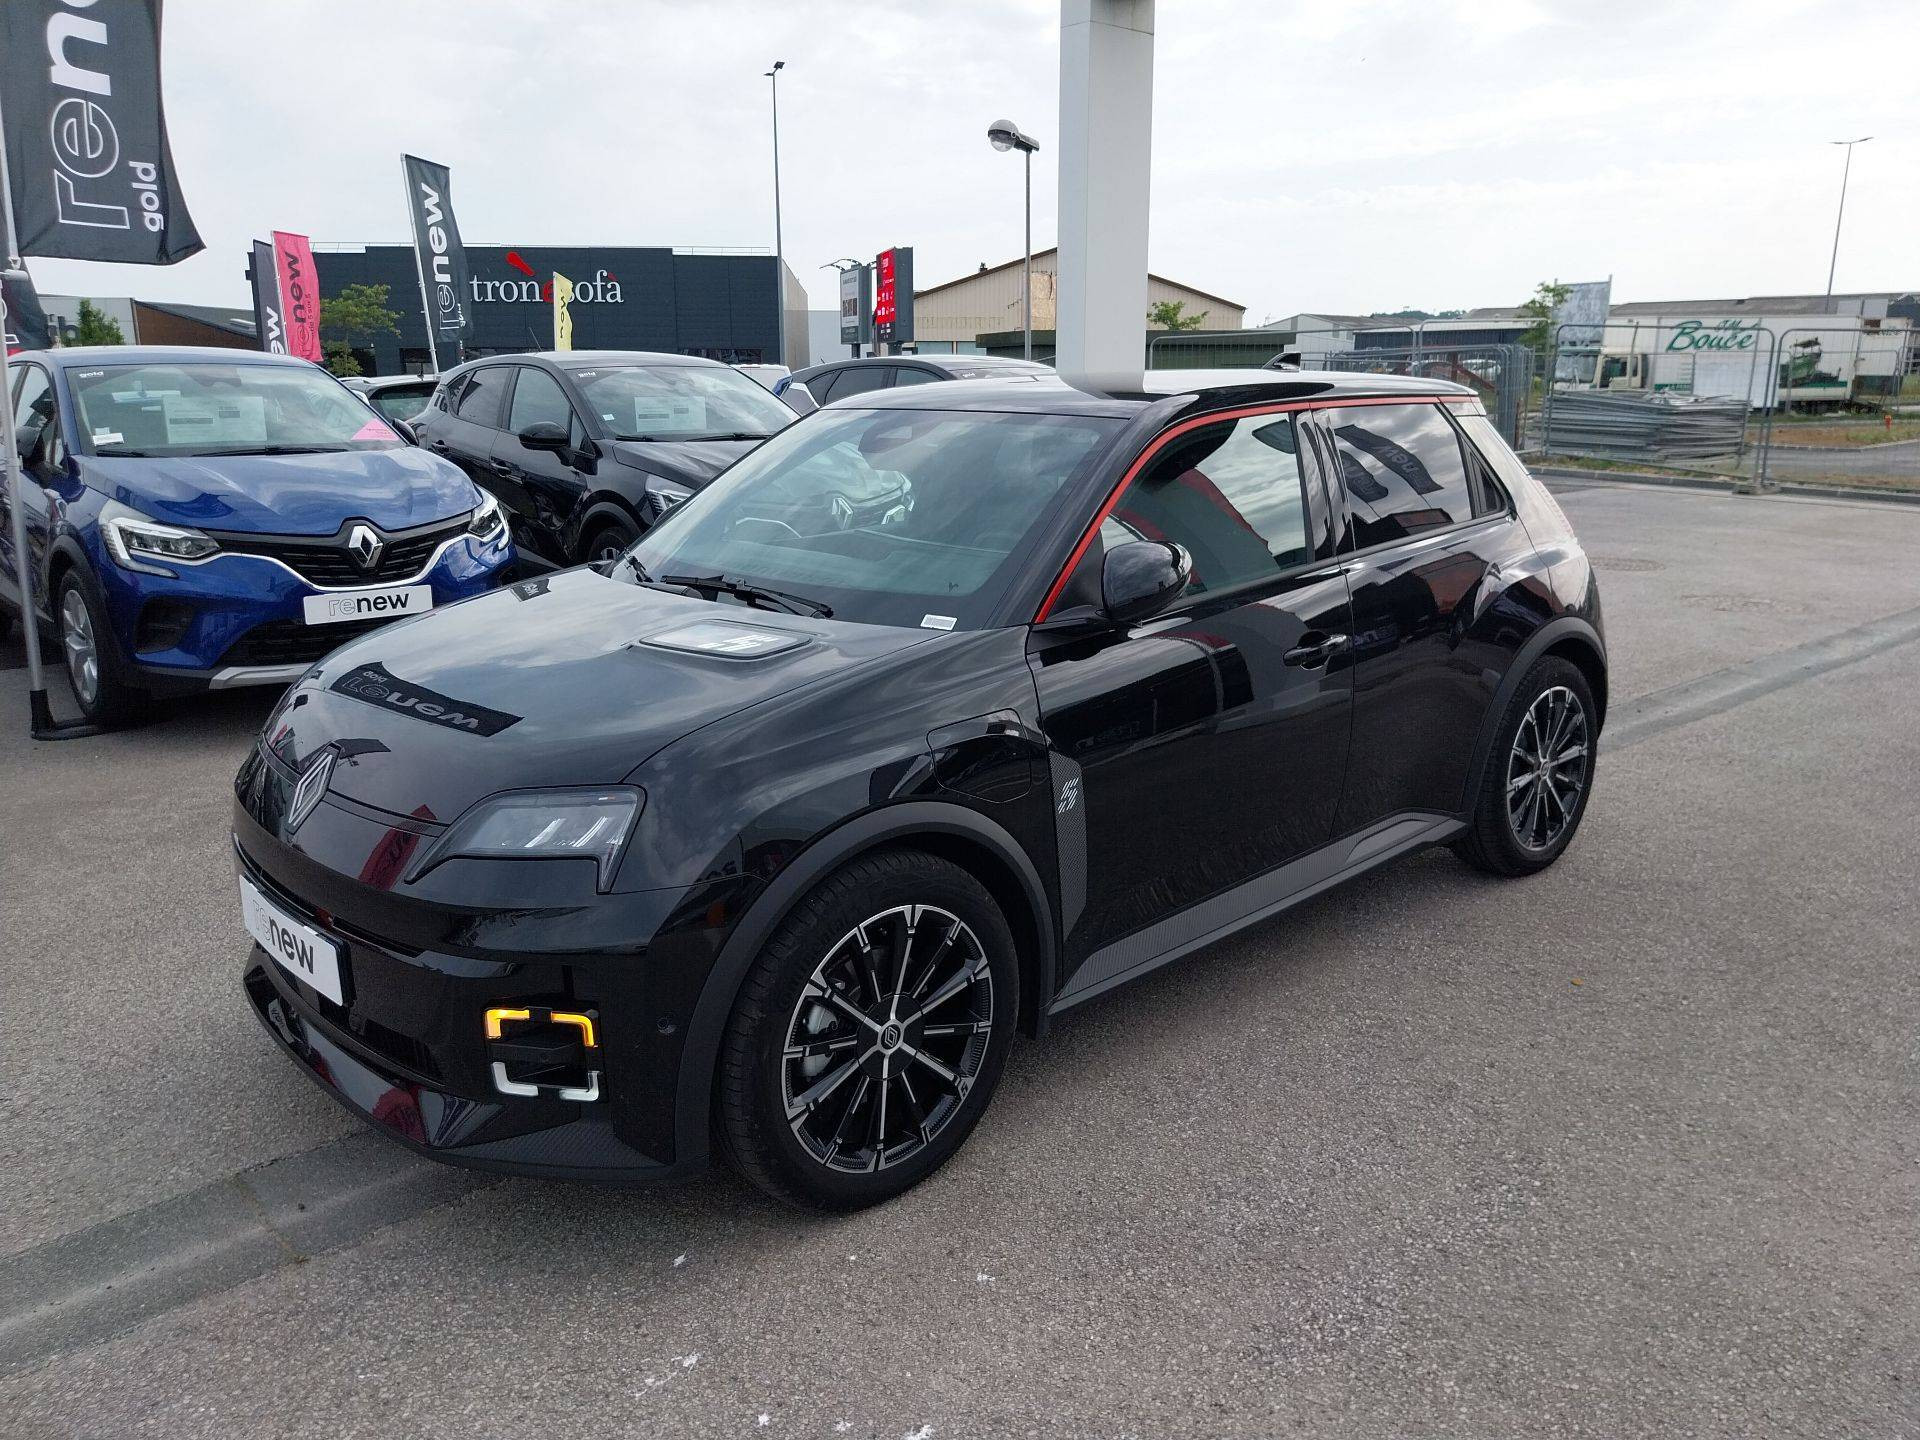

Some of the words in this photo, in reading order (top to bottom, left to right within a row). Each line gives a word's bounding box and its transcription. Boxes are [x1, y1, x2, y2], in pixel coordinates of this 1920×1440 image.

[47, 0, 130, 229] ren
[129, 161, 164, 232] gold
[421, 183, 460, 329] renew
[328, 593, 409, 616] renew
[253, 900, 314, 974] renew
